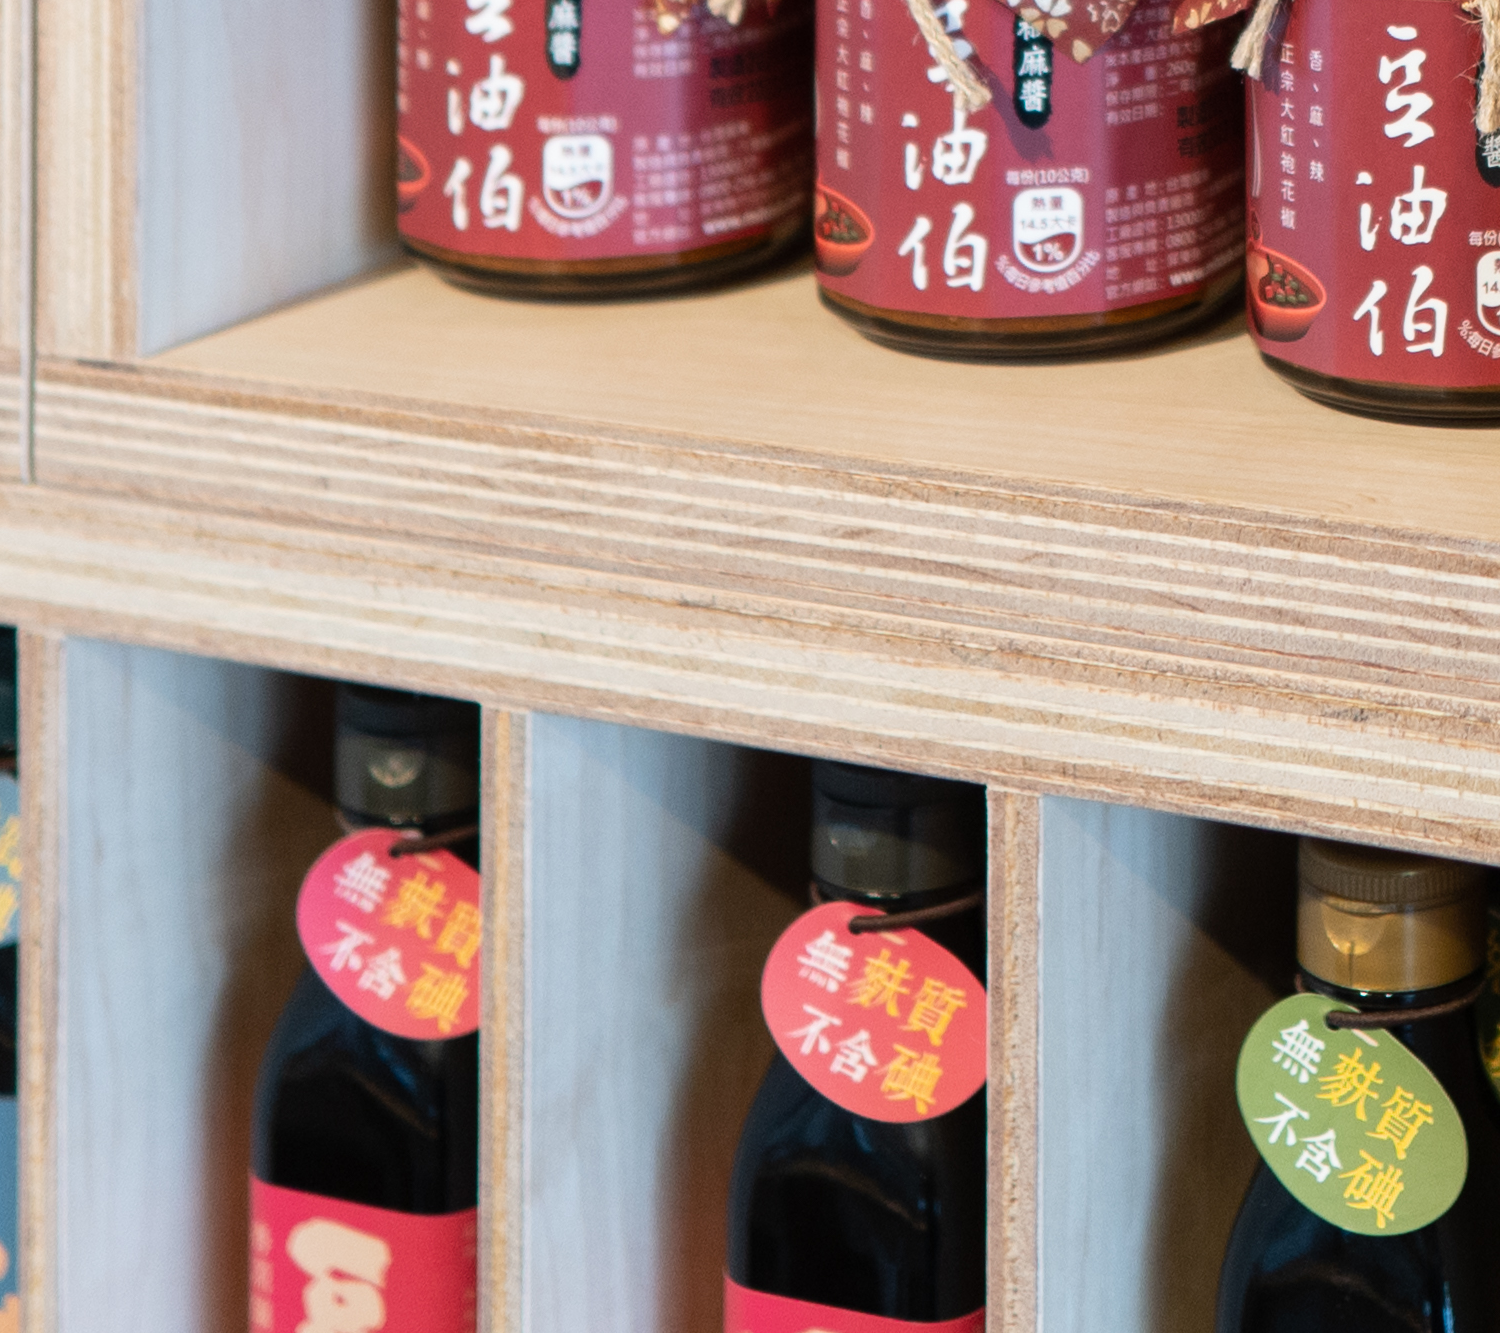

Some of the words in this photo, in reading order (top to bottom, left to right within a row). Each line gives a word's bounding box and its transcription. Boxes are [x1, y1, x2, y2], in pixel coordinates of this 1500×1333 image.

[1309, 50, 1325, 183] 香、麻、辣
[1031, 195, 1065, 211] 熱量
[1032, 243, 1064, 263] 1%
[1353, 25, 1448, 357] 豆油伯
[785, 1004, 944, 1116] 不含碘
[1271, 1019, 1435, 1161] 無麩質
[1252, 1090, 1405, 1230] 不含碘
